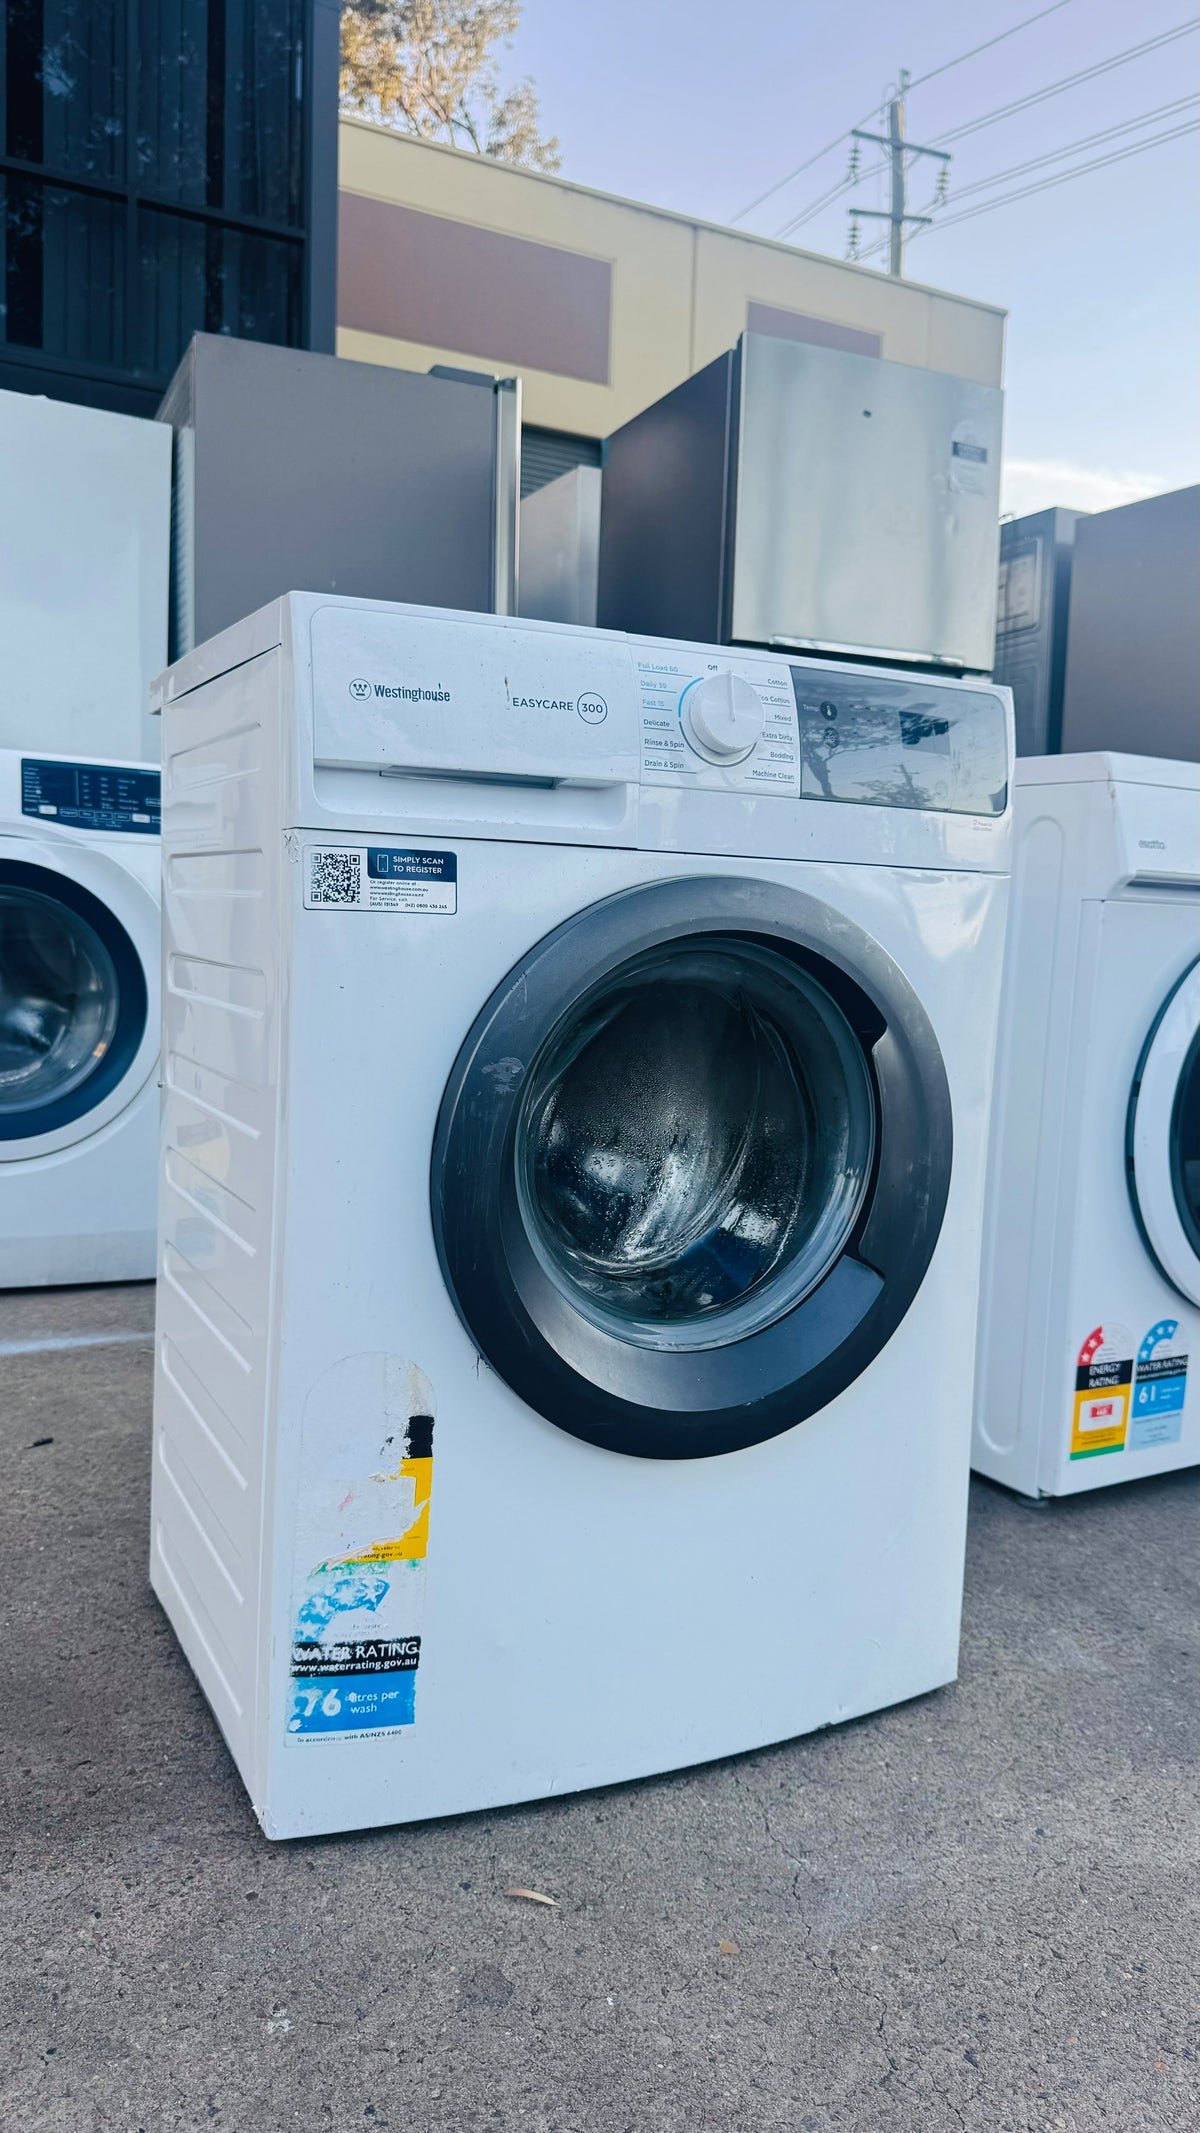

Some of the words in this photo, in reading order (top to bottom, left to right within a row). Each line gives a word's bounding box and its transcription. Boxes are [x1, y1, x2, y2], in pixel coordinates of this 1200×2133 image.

[638, 662, 651, 670] Full
[640, 680, 657, 689] Daily
[767, 678, 788, 686] Cotton
[374, 684, 451, 702] Westinghouse
[642, 699, 656, 707] Fast
[769, 696, 790, 704] Cotton
[512, 697, 574, 711] EASYCARE
[582, 703, 603, 714] 300
[803, 704, 819, 712] Temp
[643, 719, 670, 727] Delicate
[774, 714, 792, 722] Mixed
[778, 733, 793, 741] Dirty
[644, 738, 662, 746] Rinse
[669, 741, 685, 749] Spin
[770, 751, 794, 760] Bedding
[644, 759, 662, 768] Drain
[669, 761, 684, 769] Spin
[752, 769, 777, 778] Machine
[777, 772, 795, 780] Clean
[392, 855, 421, 865] SIMPLY
[422, 857, 444, 865] SCAN
[392, 865, 404, 873] TO
[406, 865, 442, 874] REGISTER
[1089, 1363, 1120, 1376] ENERGY
[1137, 1362, 1161, 1372] WATER
[1088, 1374, 1120, 1388] RATING
[293, 1645, 352, 1662] WATER
[355, 1640, 419, 1660] RATING
[290, 1658, 417, 1673] www.waterrating.gov.au
[300, 1687, 342, 1717] 76
[381, 1691, 400, 1703] per
[350, 1703, 378, 1714] wash
